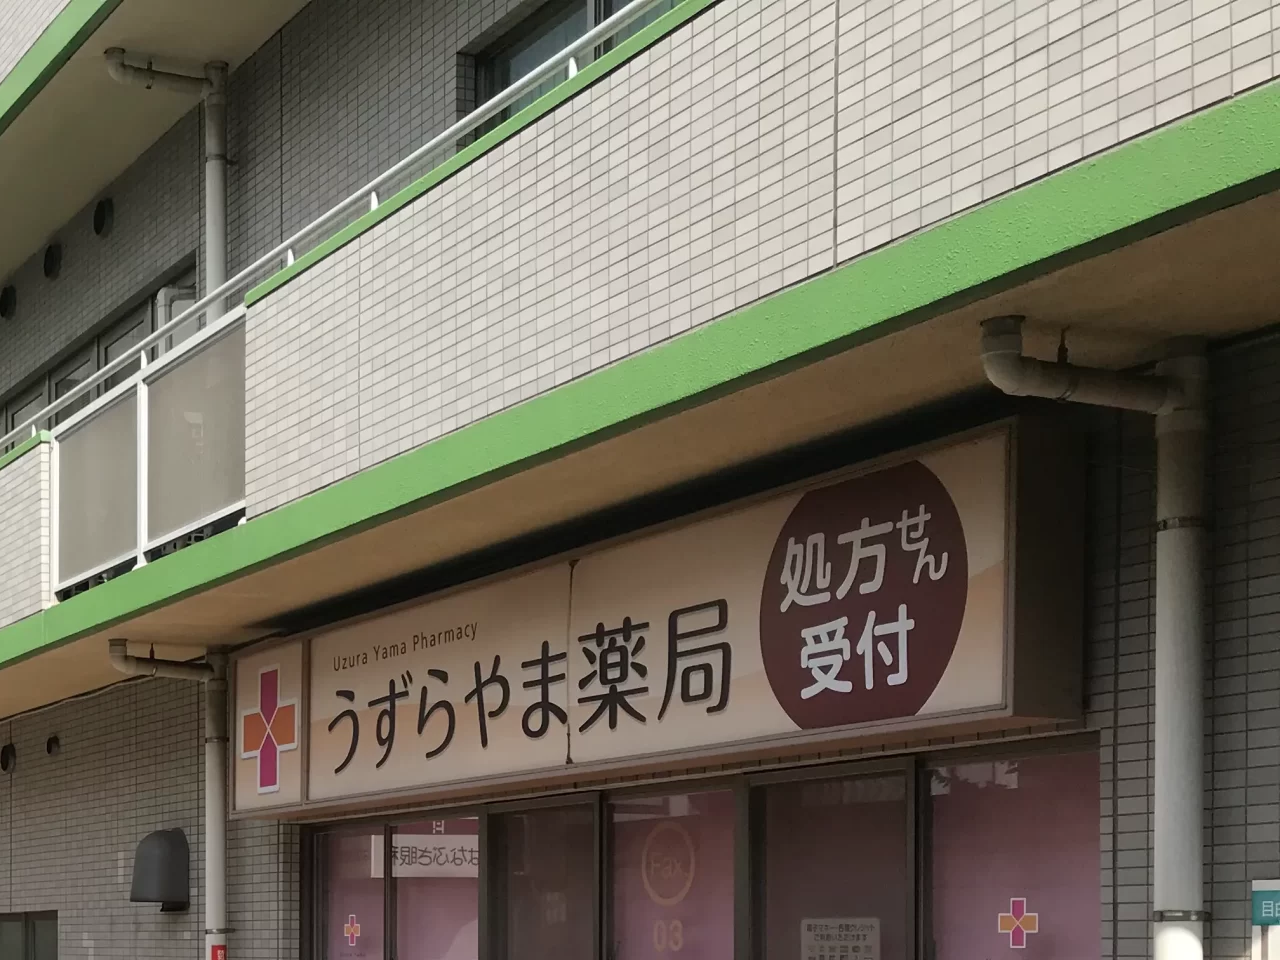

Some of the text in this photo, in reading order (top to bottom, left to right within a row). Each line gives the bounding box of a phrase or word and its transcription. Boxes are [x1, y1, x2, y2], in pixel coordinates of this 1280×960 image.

[780, 504, 948, 613] 処方せん
[327, 598, 732, 775] うずらやま薬局
[333, 622, 478, 672] Uzura Yama Pharmacy
[800, 603, 915, 700] 受付
[653, 919, 684, 952] 03
